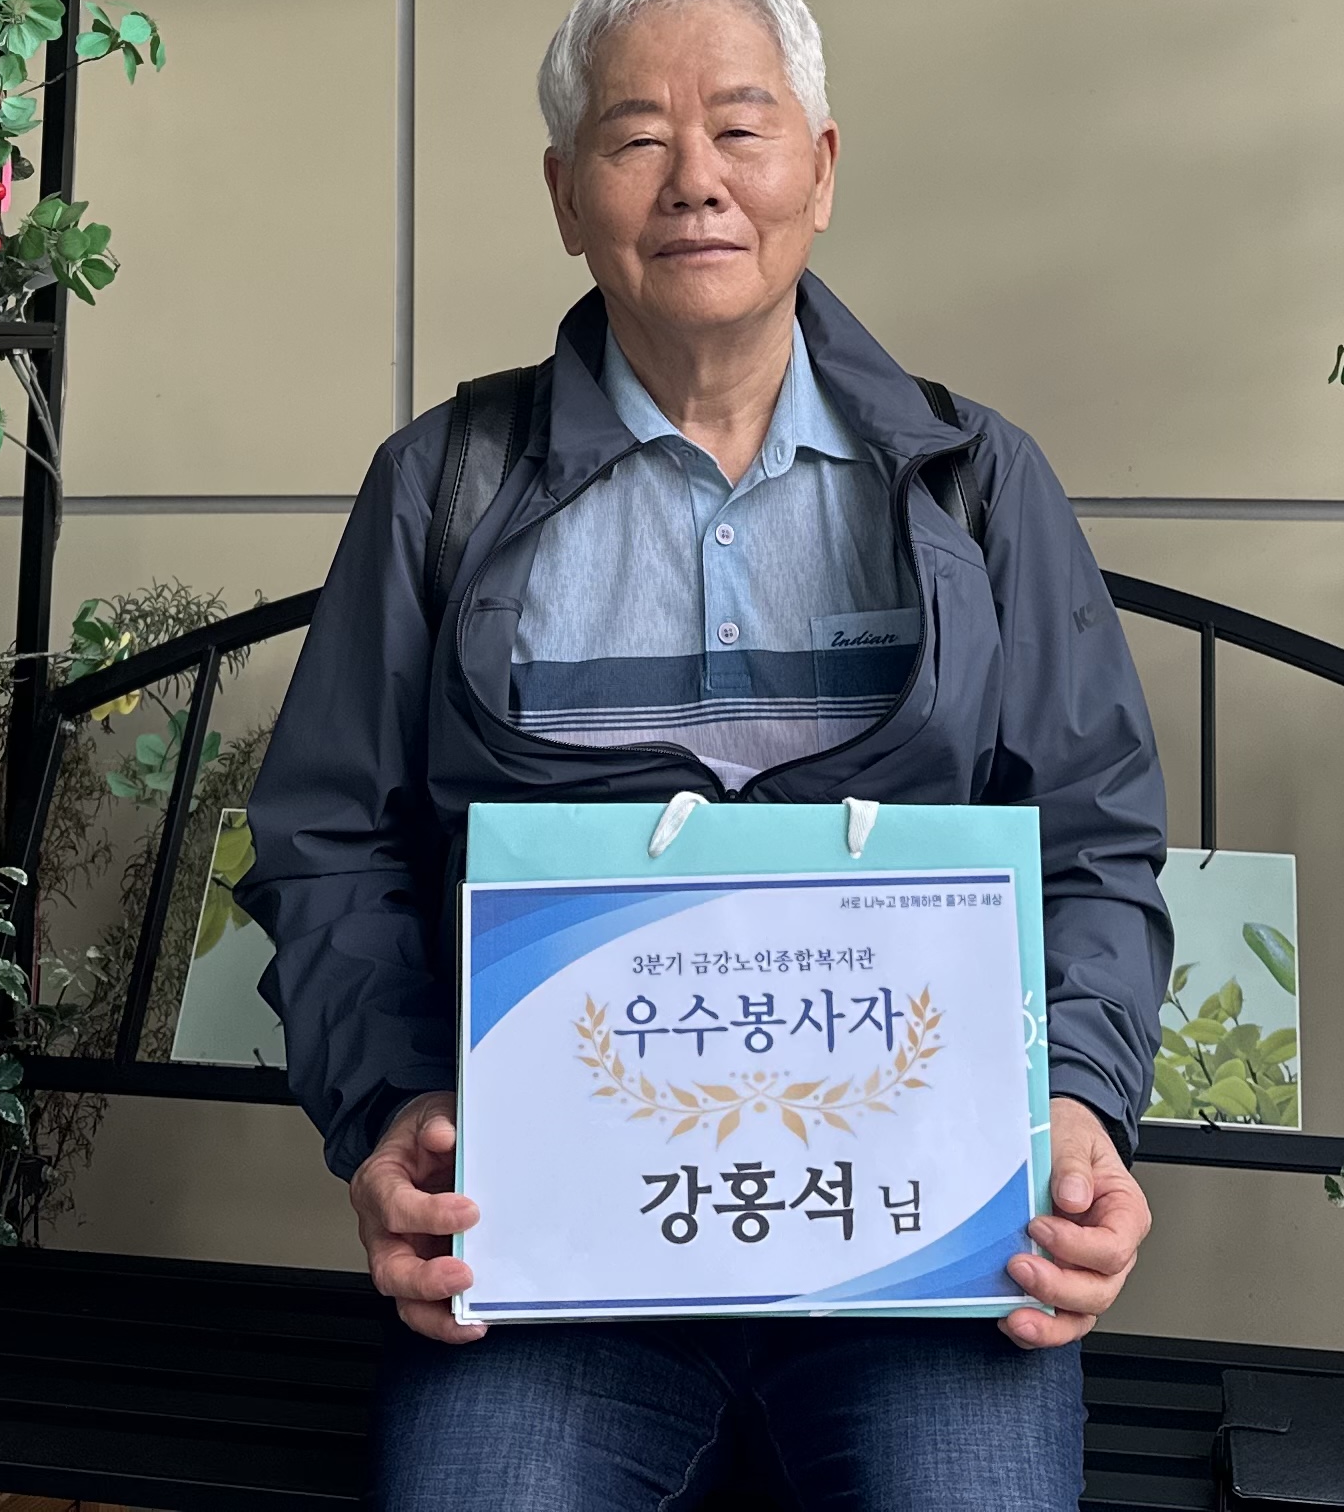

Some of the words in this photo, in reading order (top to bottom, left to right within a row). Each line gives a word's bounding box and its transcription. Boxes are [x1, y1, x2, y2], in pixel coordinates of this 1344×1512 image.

[831, 631, 899, 648] Indian
[840, 896, 861, 909] 서로
[864, 895, 897, 909] 나누고
[899, 894, 943, 909] 함께하면
[946, 893, 978, 908] 즐거운
[980, 893, 1003, 907] 세상
[632, 951, 683, 976] 3분기
[690, 947, 876, 975] 금강노인종합복지관
[612, 987, 906, 1059] 우수봉사자
[638, 1160, 856, 1245] 강홍석
[877, 1179, 923, 1236] 님
